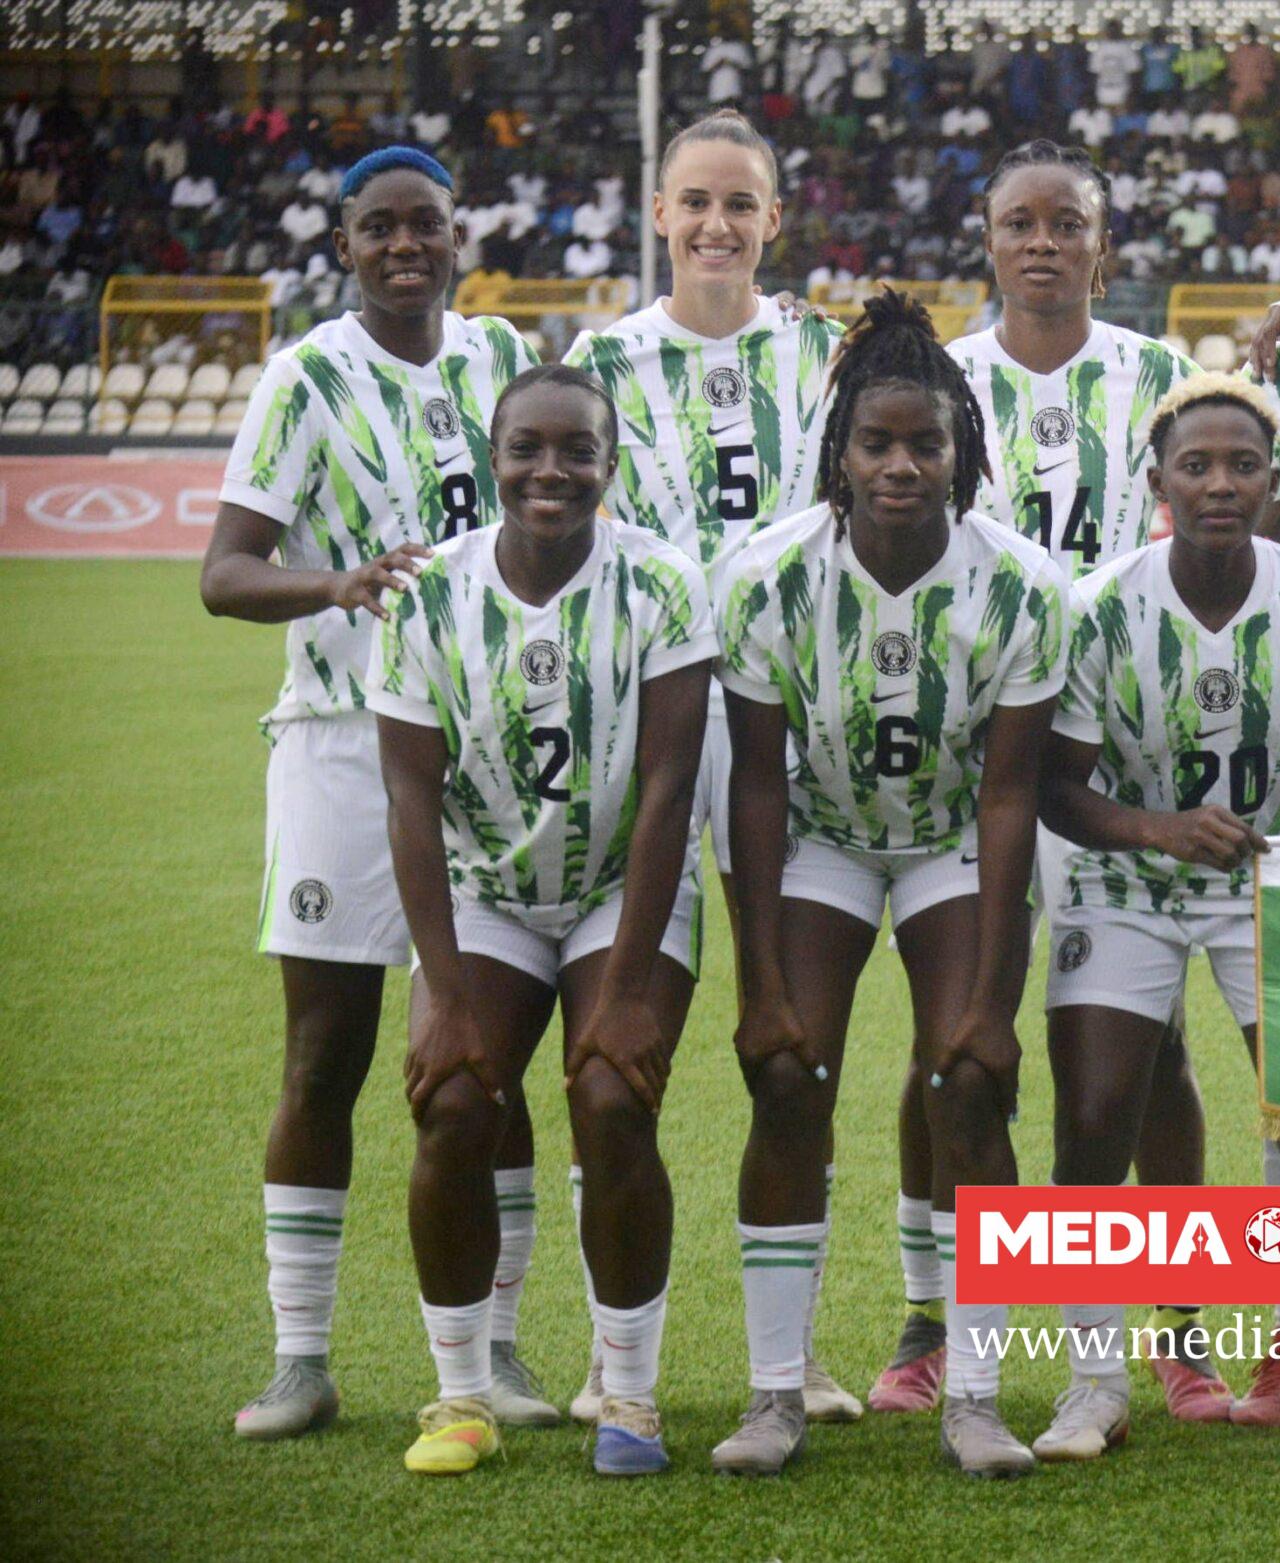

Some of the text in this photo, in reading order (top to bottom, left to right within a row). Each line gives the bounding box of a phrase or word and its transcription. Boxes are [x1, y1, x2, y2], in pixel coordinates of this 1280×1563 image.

[441, 472, 478, 544] 8
[715, 444, 759, 521] 5
[1023, 486, 1102, 563] 14
[529, 727, 571, 802] 2
[876, 715, 920, 778] 6
[1177, 747, 1268, 815] 20
